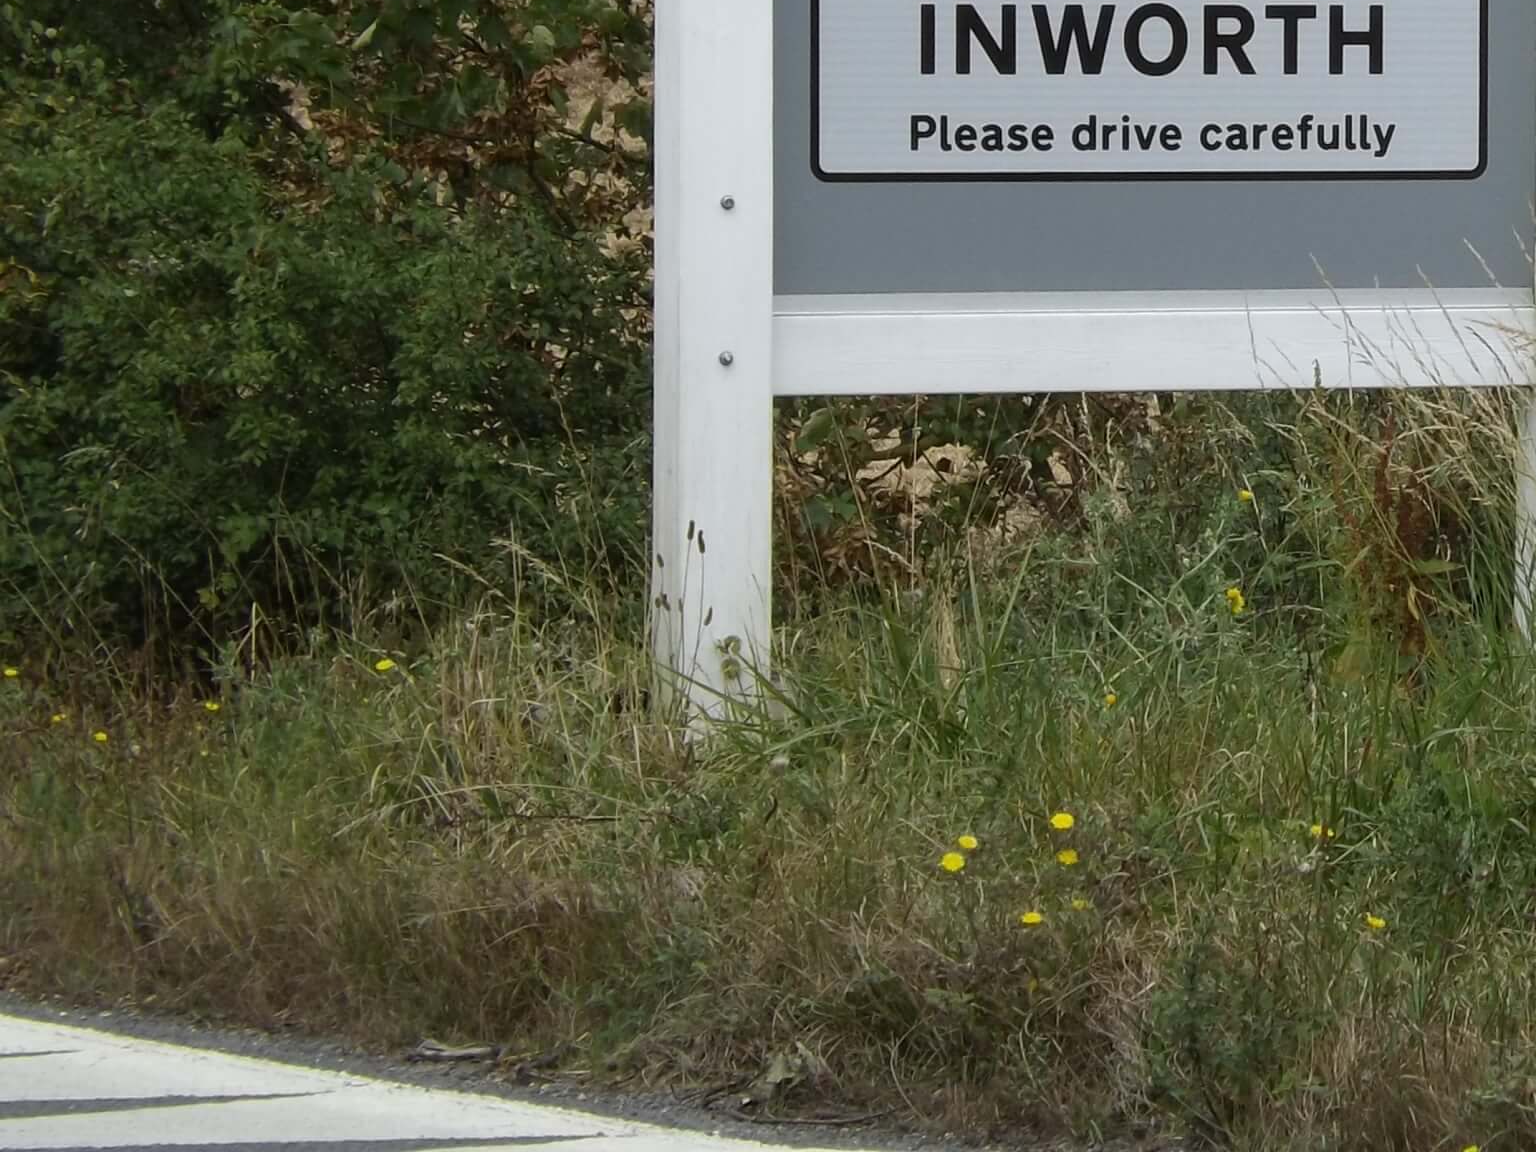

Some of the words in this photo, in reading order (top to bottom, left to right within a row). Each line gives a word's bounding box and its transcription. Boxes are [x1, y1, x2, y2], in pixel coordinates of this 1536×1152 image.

[919, 2, 1385, 77] INWORTH
[909, 114, 1055, 152] Please
[1071, 114, 1183, 152] drive
[1199, 114, 1397, 158] carefully
